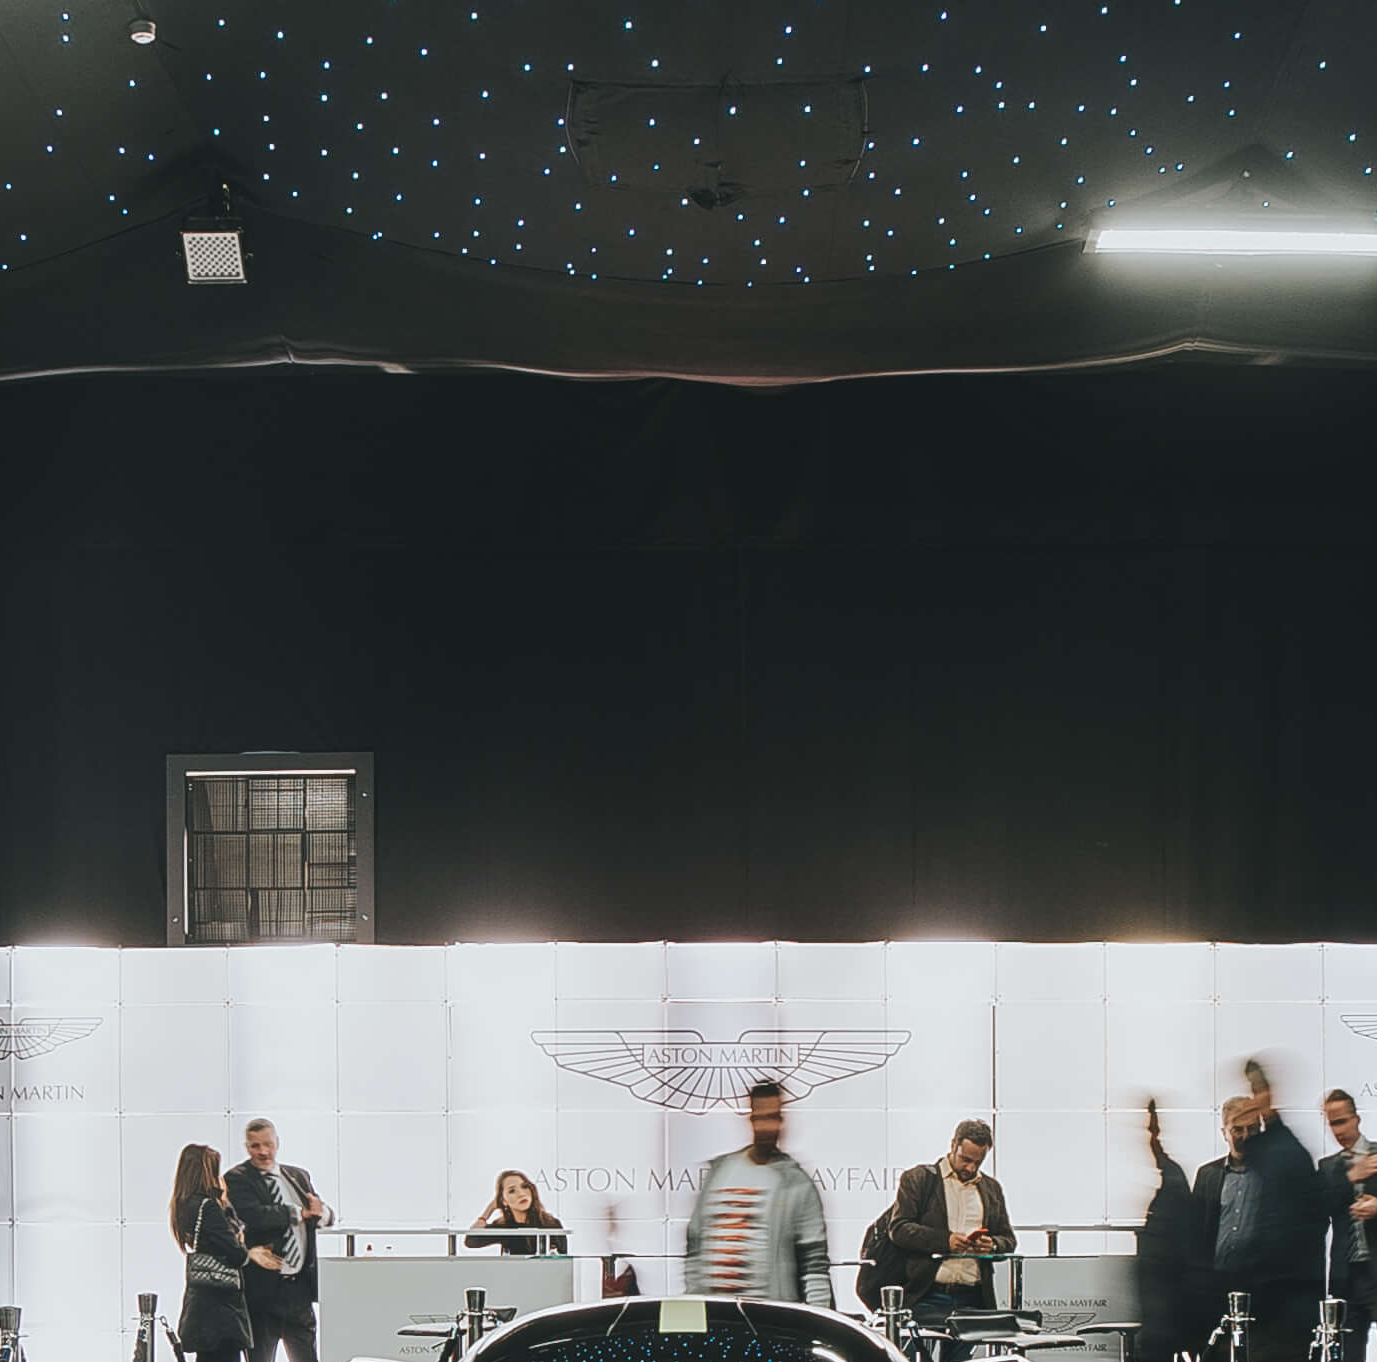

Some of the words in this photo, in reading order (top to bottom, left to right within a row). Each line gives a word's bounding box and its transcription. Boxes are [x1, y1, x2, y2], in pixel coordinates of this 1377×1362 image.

[647, 1047, 713, 1064] ASTON
[719, 1047, 794, 1063] MARTIN
[10, 1085, 85, 1101] MARTIN
[533, 1167, 636, 1192] ASTON
[399, 1346, 430, 1354] ASTON
